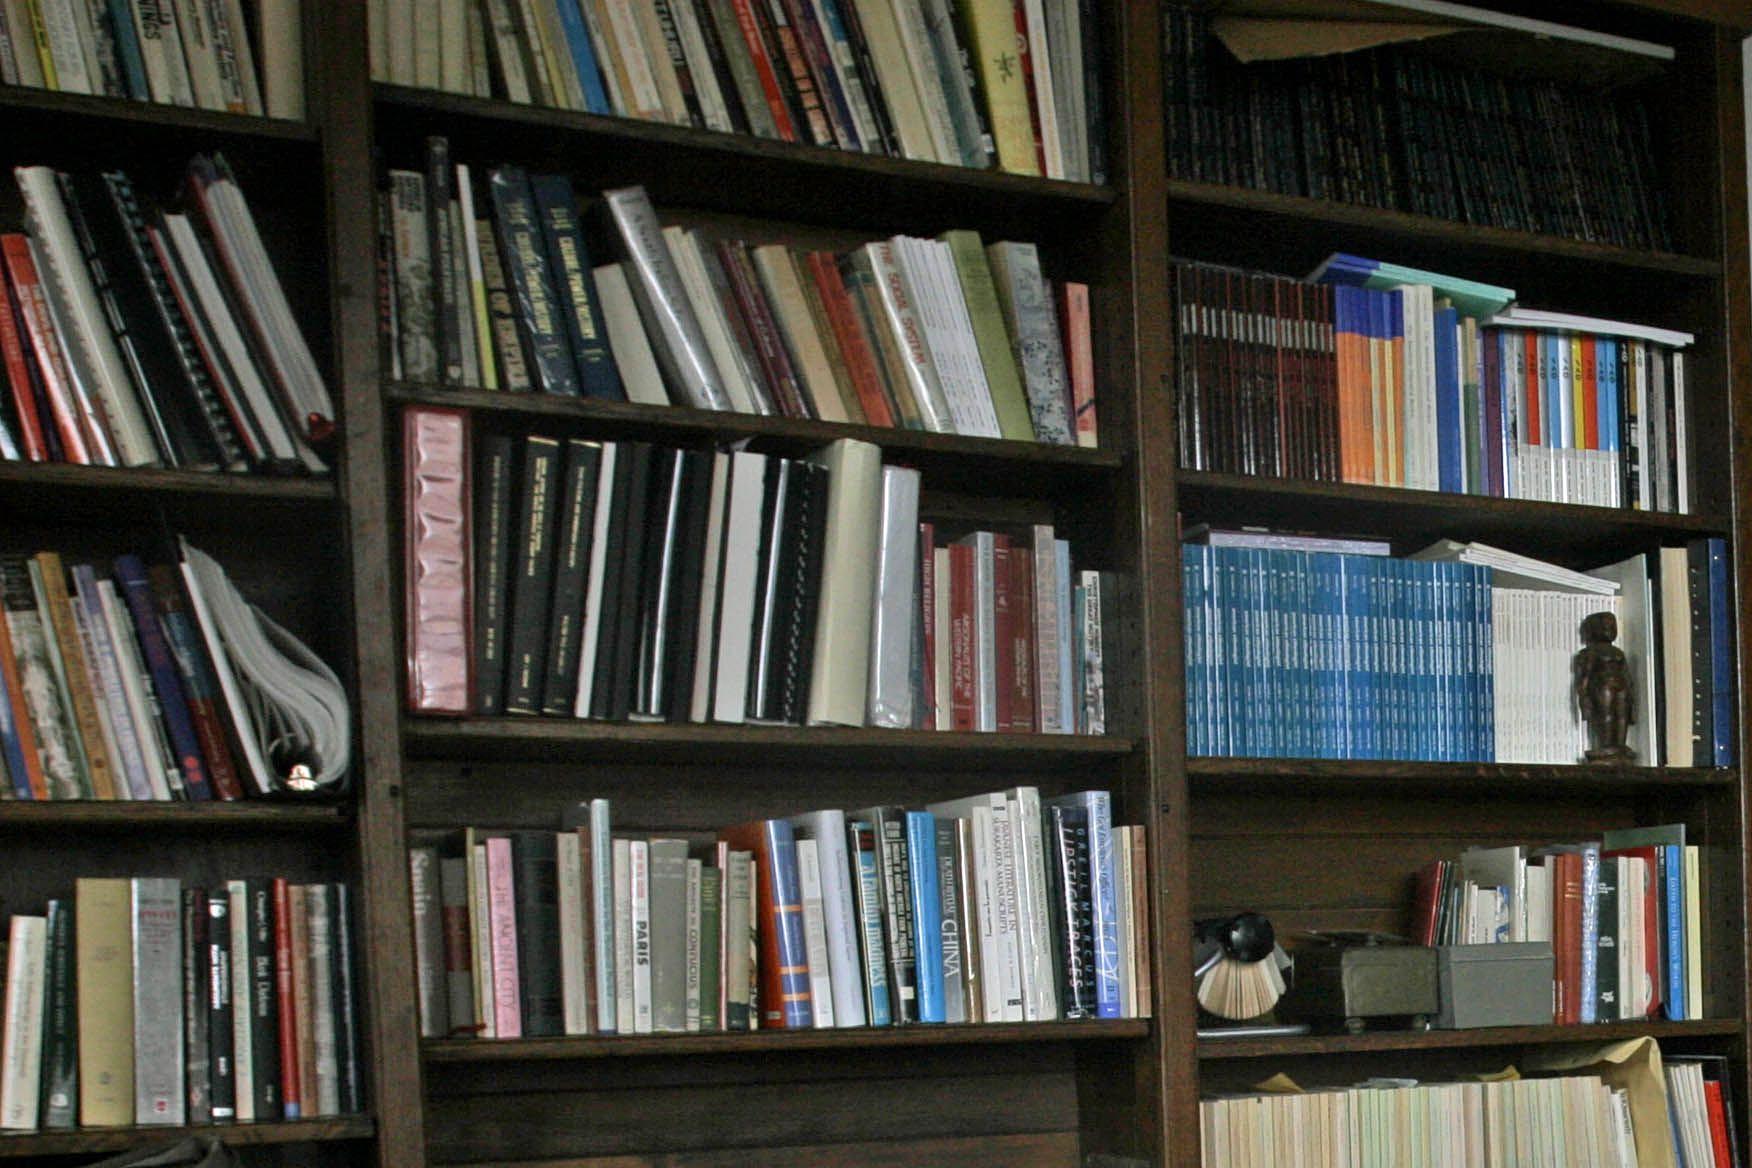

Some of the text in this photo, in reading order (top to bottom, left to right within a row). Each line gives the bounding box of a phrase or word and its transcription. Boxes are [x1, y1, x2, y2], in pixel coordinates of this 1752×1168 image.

[901, 316, 926, 366] SYSTEM
[1060, 827, 1083, 990] LIPSTICK TRACES
[1075, 827, 1095, 989] GREIL MARCUS
[636, 920, 649, 966] PARIS
[689, 929, 699, 990] CONFUCIUS
[866, 926, 888, 988] madness
[940, 918, 960, 977] CHINA
[501, 976, 516, 1010] CITY
